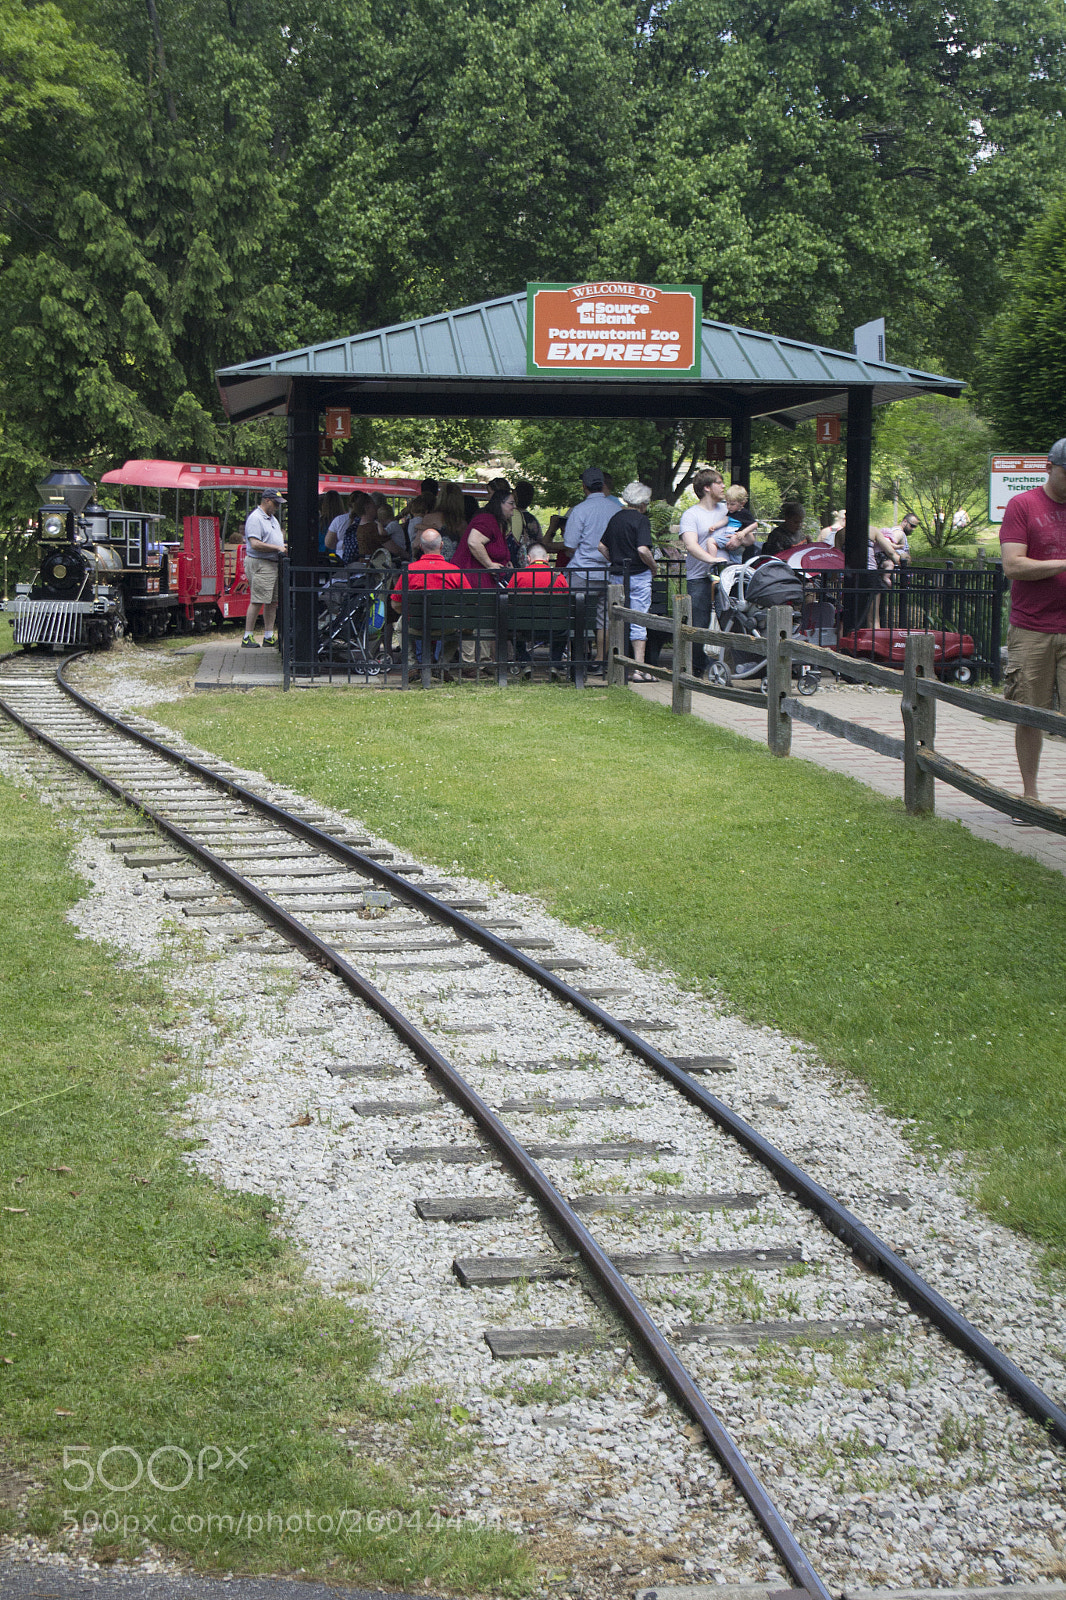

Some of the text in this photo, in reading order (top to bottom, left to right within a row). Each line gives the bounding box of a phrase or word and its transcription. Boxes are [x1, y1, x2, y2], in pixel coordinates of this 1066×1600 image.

[572, 284, 656, 299] WELCOME TO
[595, 302, 650, 314] Source
[595, 313, 637, 325] Bank
[548, 328, 680, 341] Potawatomi Zoo
[547, 343, 681, 362] EXPRESS
[335, 416, 344, 430] 1
[823, 422, 832, 435] 1
